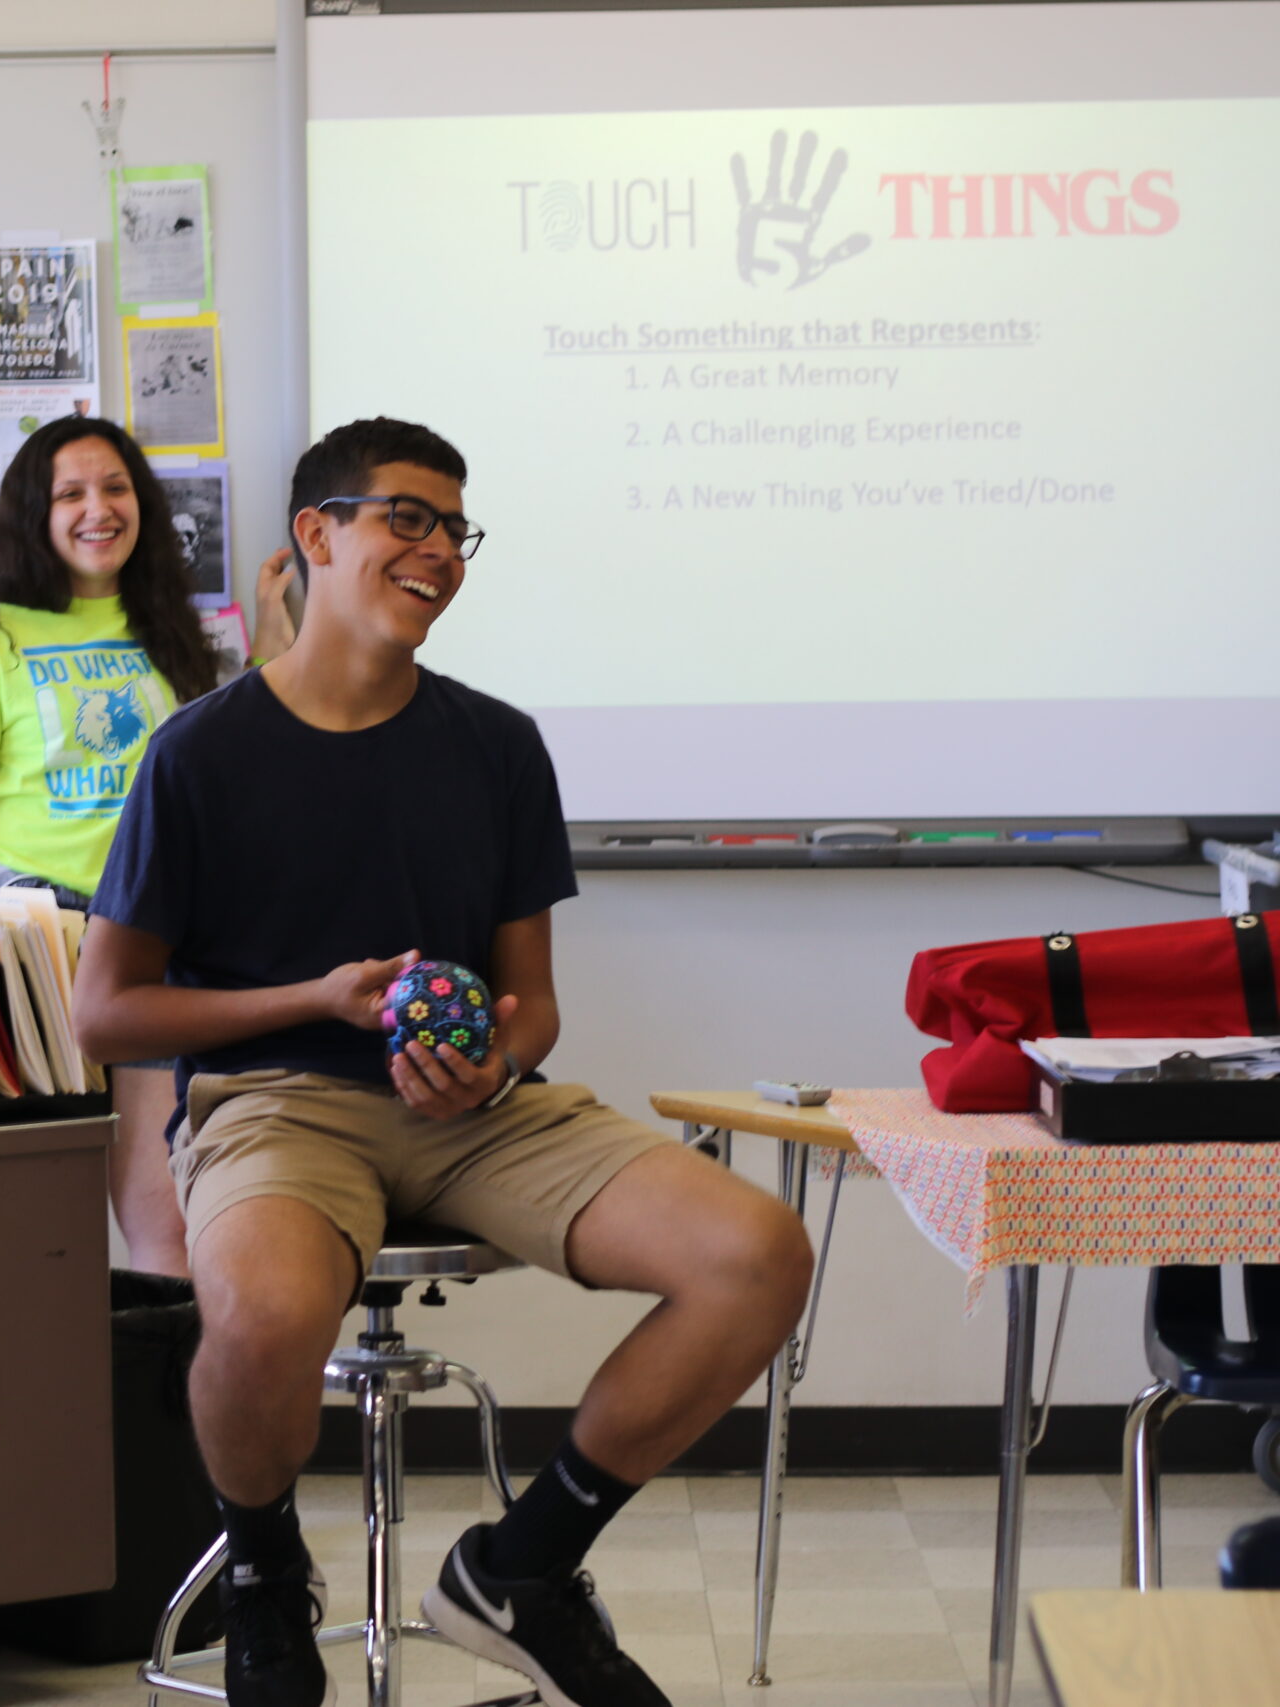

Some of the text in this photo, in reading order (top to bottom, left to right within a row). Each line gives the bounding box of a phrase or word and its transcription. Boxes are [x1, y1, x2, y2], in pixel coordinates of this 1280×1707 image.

[506, 177, 695, 252] TOUCH
[878, 167, 1181, 240] THINGS
[545, 317, 1042, 350] Touch Something that Represents:
[625, 362, 899, 393] 1. A Great Memory
[625, 416, 1022, 450] 2. A Challenging Experience
[625, 485, 651, 511] 3.
[662, 485, 684, 510] A
[694, 484, 755, 510] New
[765, 480, 843, 515] Thing
[955, 476, 1116, 507] Tried/Done
[27, 651, 152, 687] DO WHAT
[45, 764, 128, 797] WHAT
